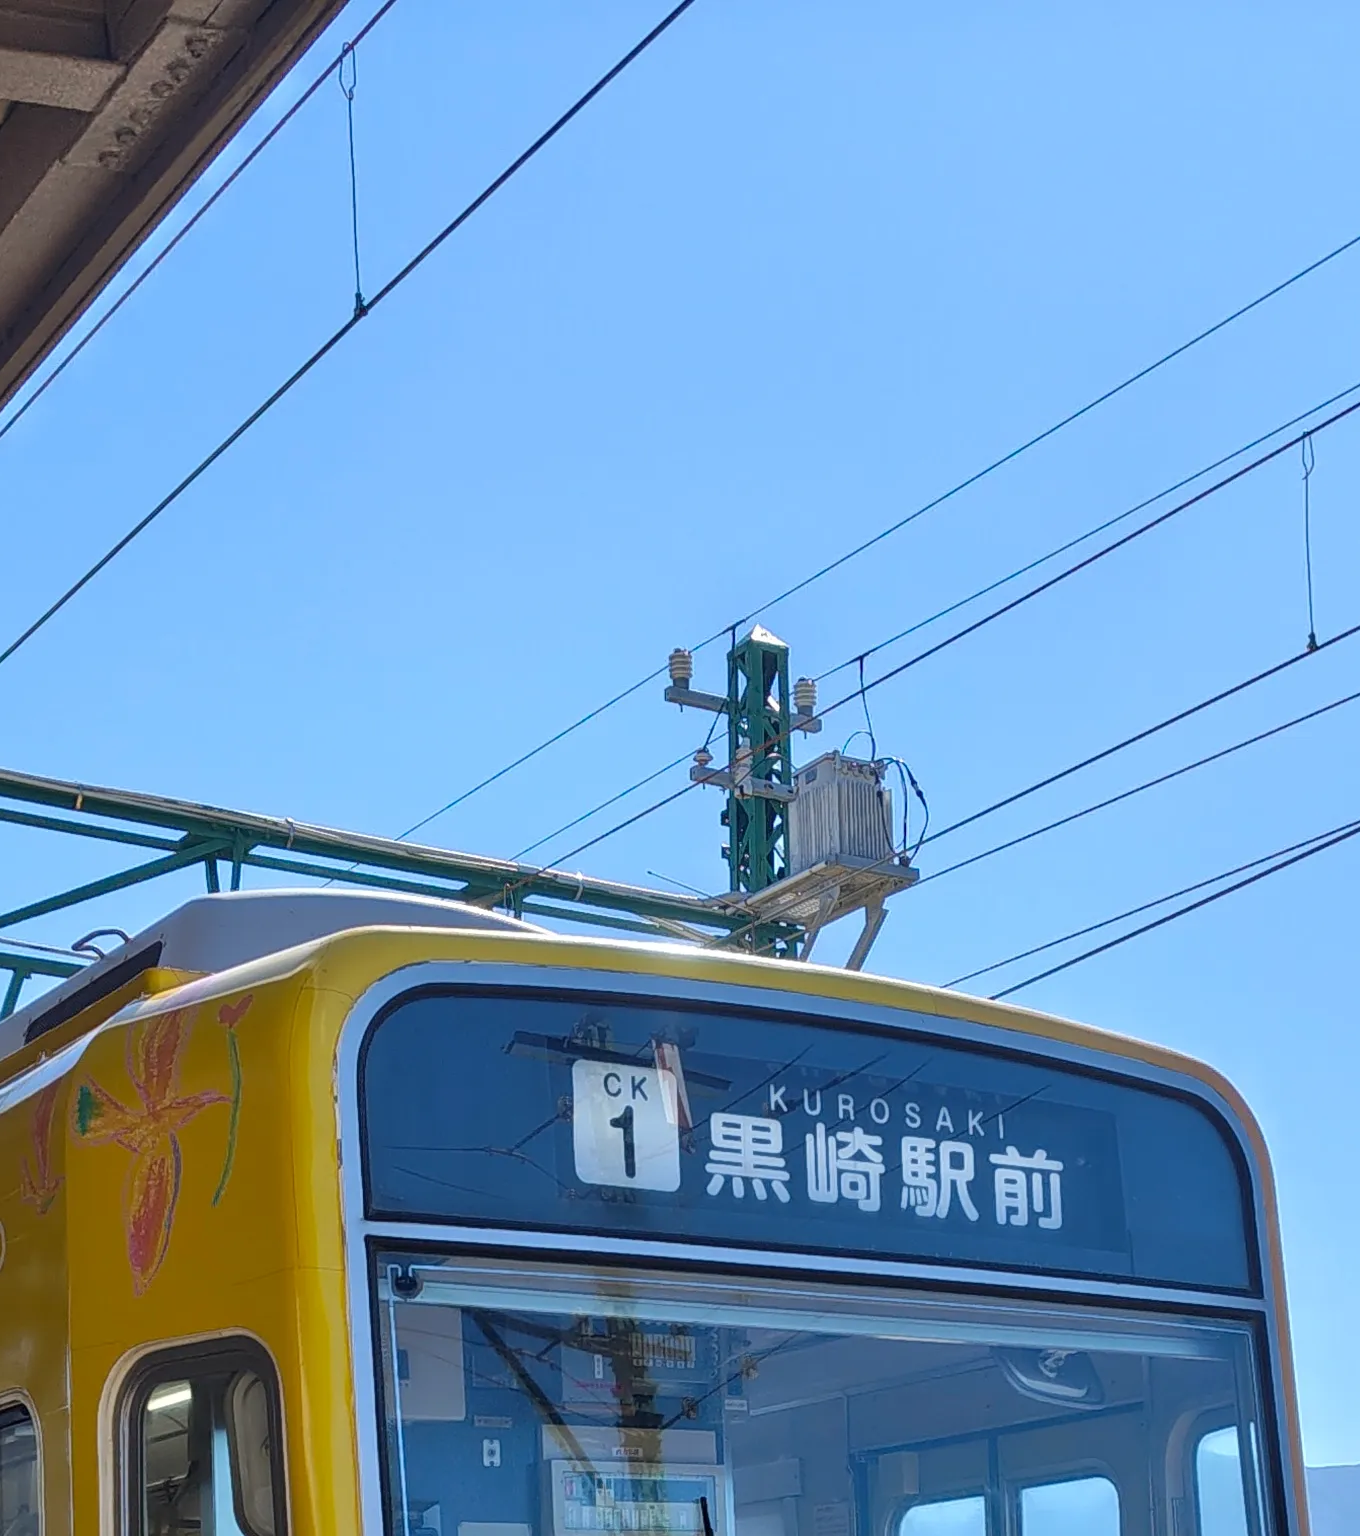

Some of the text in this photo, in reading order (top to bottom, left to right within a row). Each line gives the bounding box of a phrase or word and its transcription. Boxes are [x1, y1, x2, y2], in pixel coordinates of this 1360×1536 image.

[602, 1071, 649, 1101] CK
[769, 1082, 1005, 1141] KUROSAKI
[608, 1109, 637, 1179] 1
[705, 1110, 1064, 1231] 黒崎駅前
